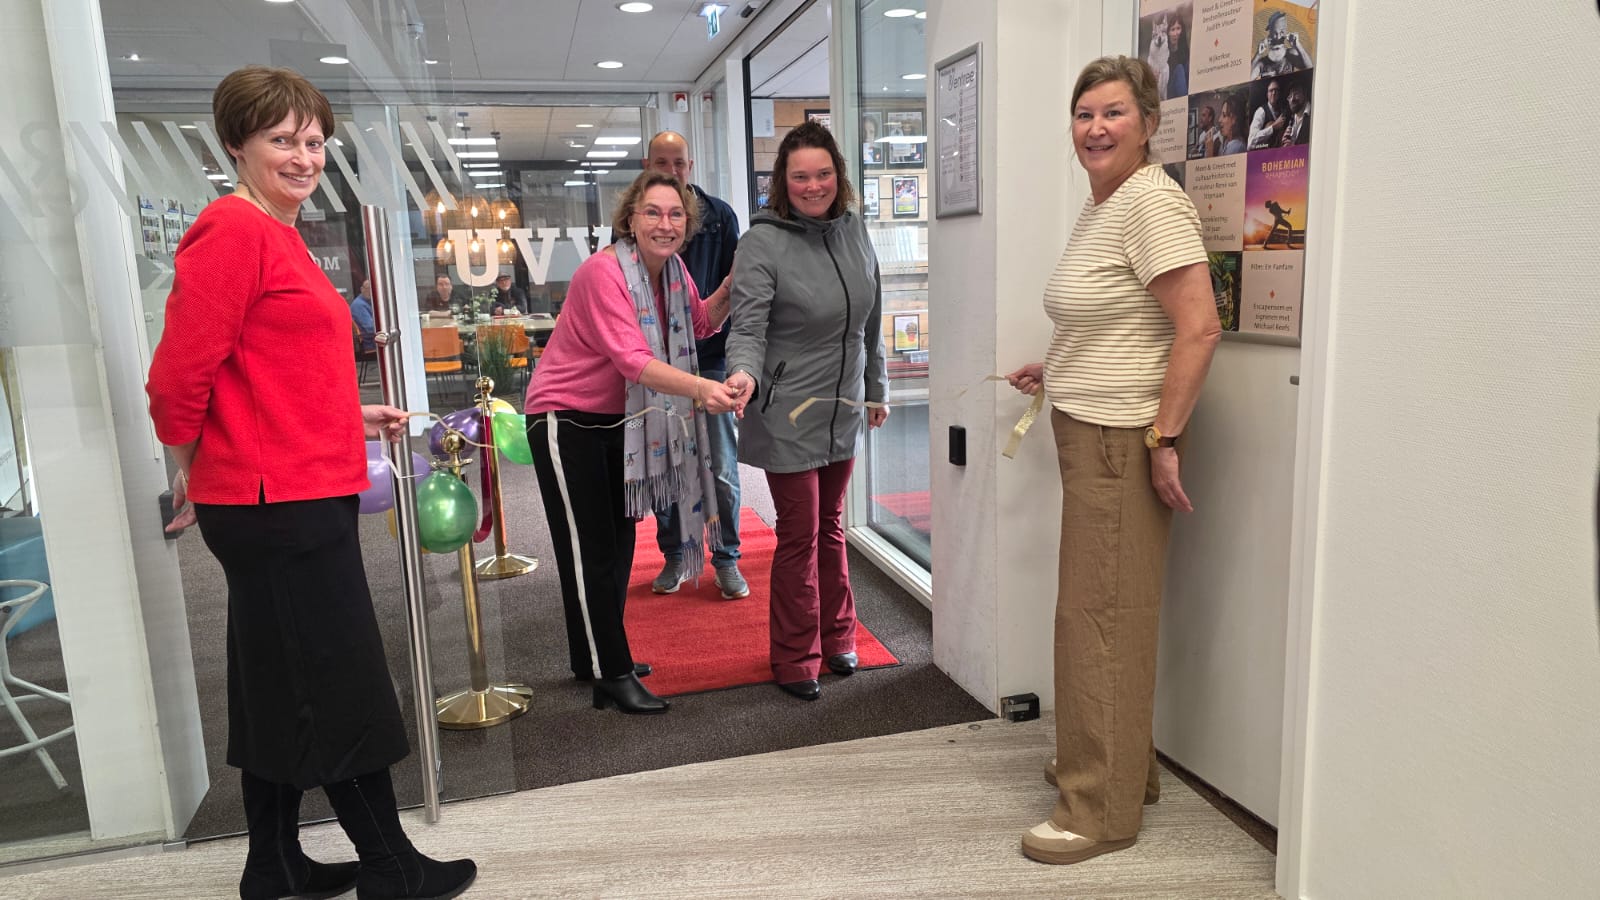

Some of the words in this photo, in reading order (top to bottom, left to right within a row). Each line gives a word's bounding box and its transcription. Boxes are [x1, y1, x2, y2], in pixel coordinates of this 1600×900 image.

[1262, 158, 1305, 173] BOHEMIAN
[1253, 303, 1284, 311] Escaperoom
[1254, 322, 1274, 330] Michael
